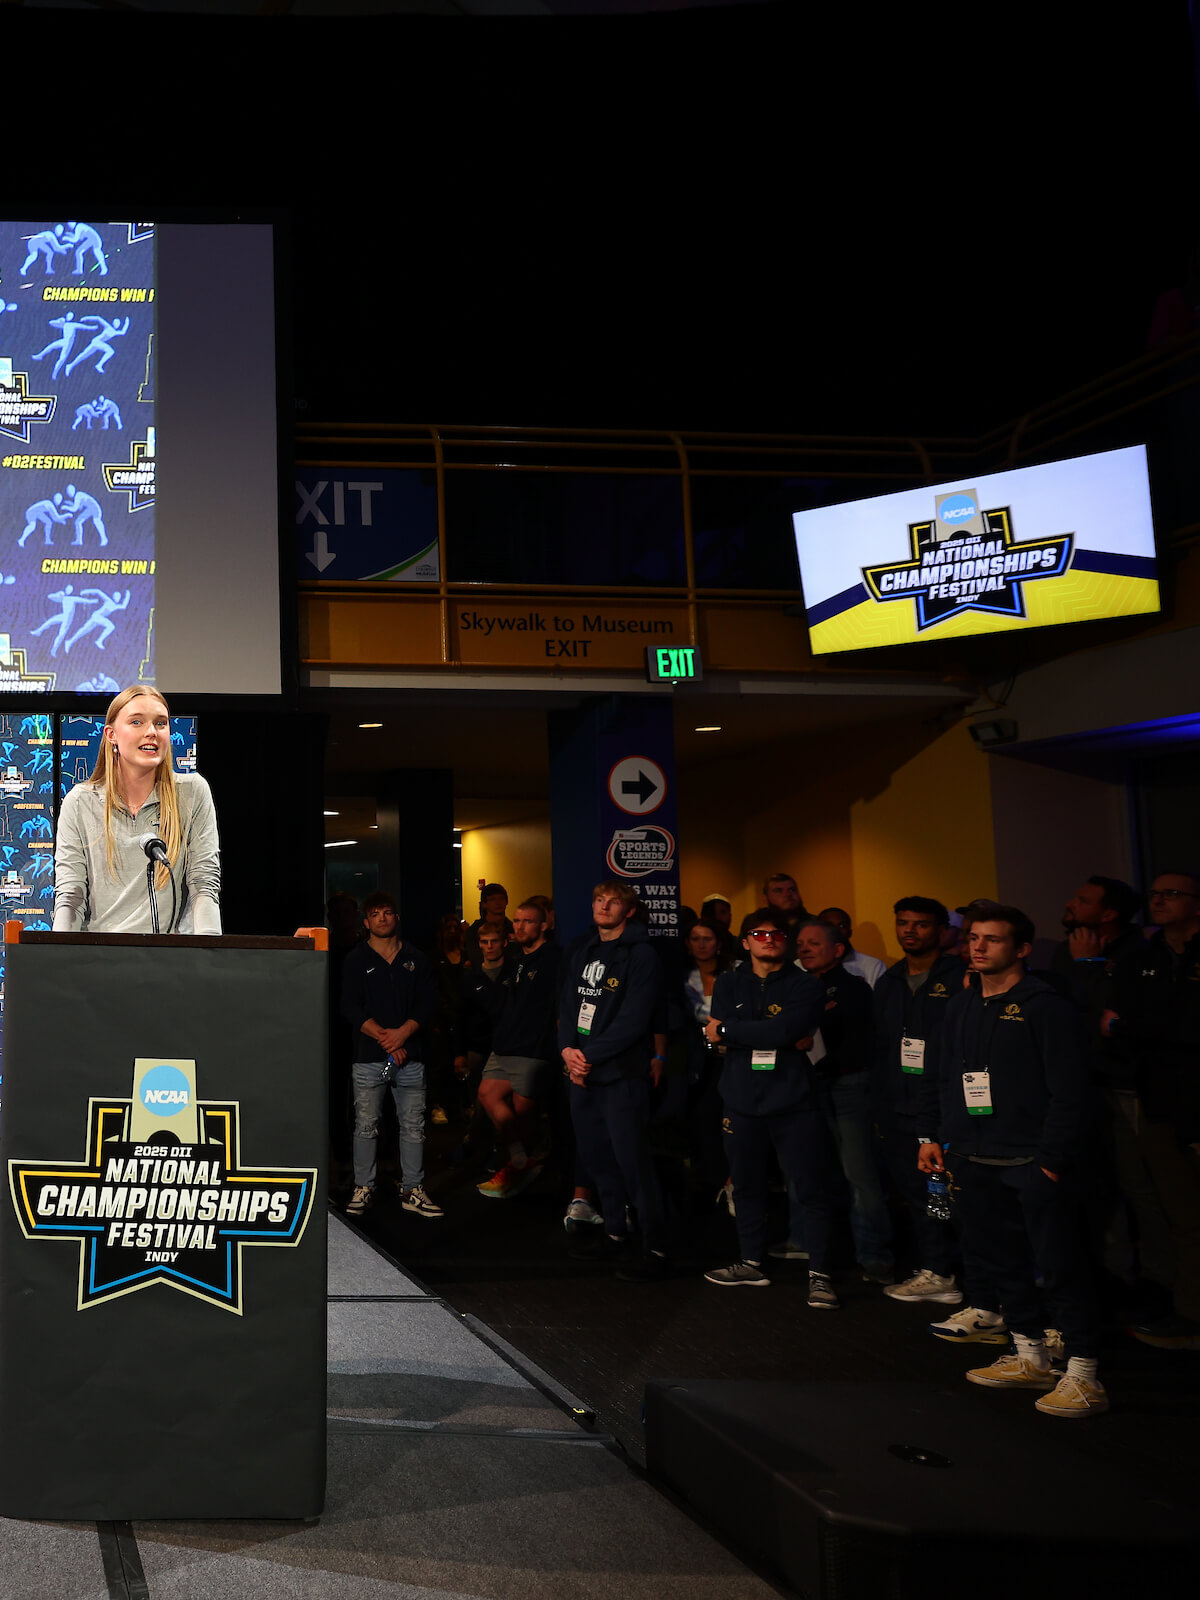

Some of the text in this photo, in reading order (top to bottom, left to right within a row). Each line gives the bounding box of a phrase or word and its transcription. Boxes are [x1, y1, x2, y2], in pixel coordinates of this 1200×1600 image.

[42, 287, 118, 301] CHAMPIONS
[120, 288, 147, 302] WIN
[2, 455, 85, 470] #D2FESTIVAL
[943, 506, 976, 520] NCAA
[922, 540, 1006, 566] NATIONAL
[42, 559, 118, 574] CHAMPIONS
[120, 560, 146, 574] WIN
[880, 547, 1058, 592] CHAMPIONSHIPS
[928, 575, 1007, 600] FESTIVAL
[955, 594, 981, 604] INDY
[459, 611, 674, 636] Skywalk to Museum
[544, 640, 592, 658] EXIT
[656, 647, 696, 678] EXIT
[618, 842, 666, 852] SPORTS
[620, 852, 664, 860] LEGENDS
[645, 884, 676, 896] WAY
[144, 1090, 188, 1106] NCAA
[134, 1146, 193, 1158] 2025 DII
[105, 1158, 222, 1186] NATIONAL
[37, 1185, 290, 1223] CHAMPIONSHIPS
[107, 1222, 217, 1250] FESTIVAL
[144, 1252, 179, 1263] INDY
